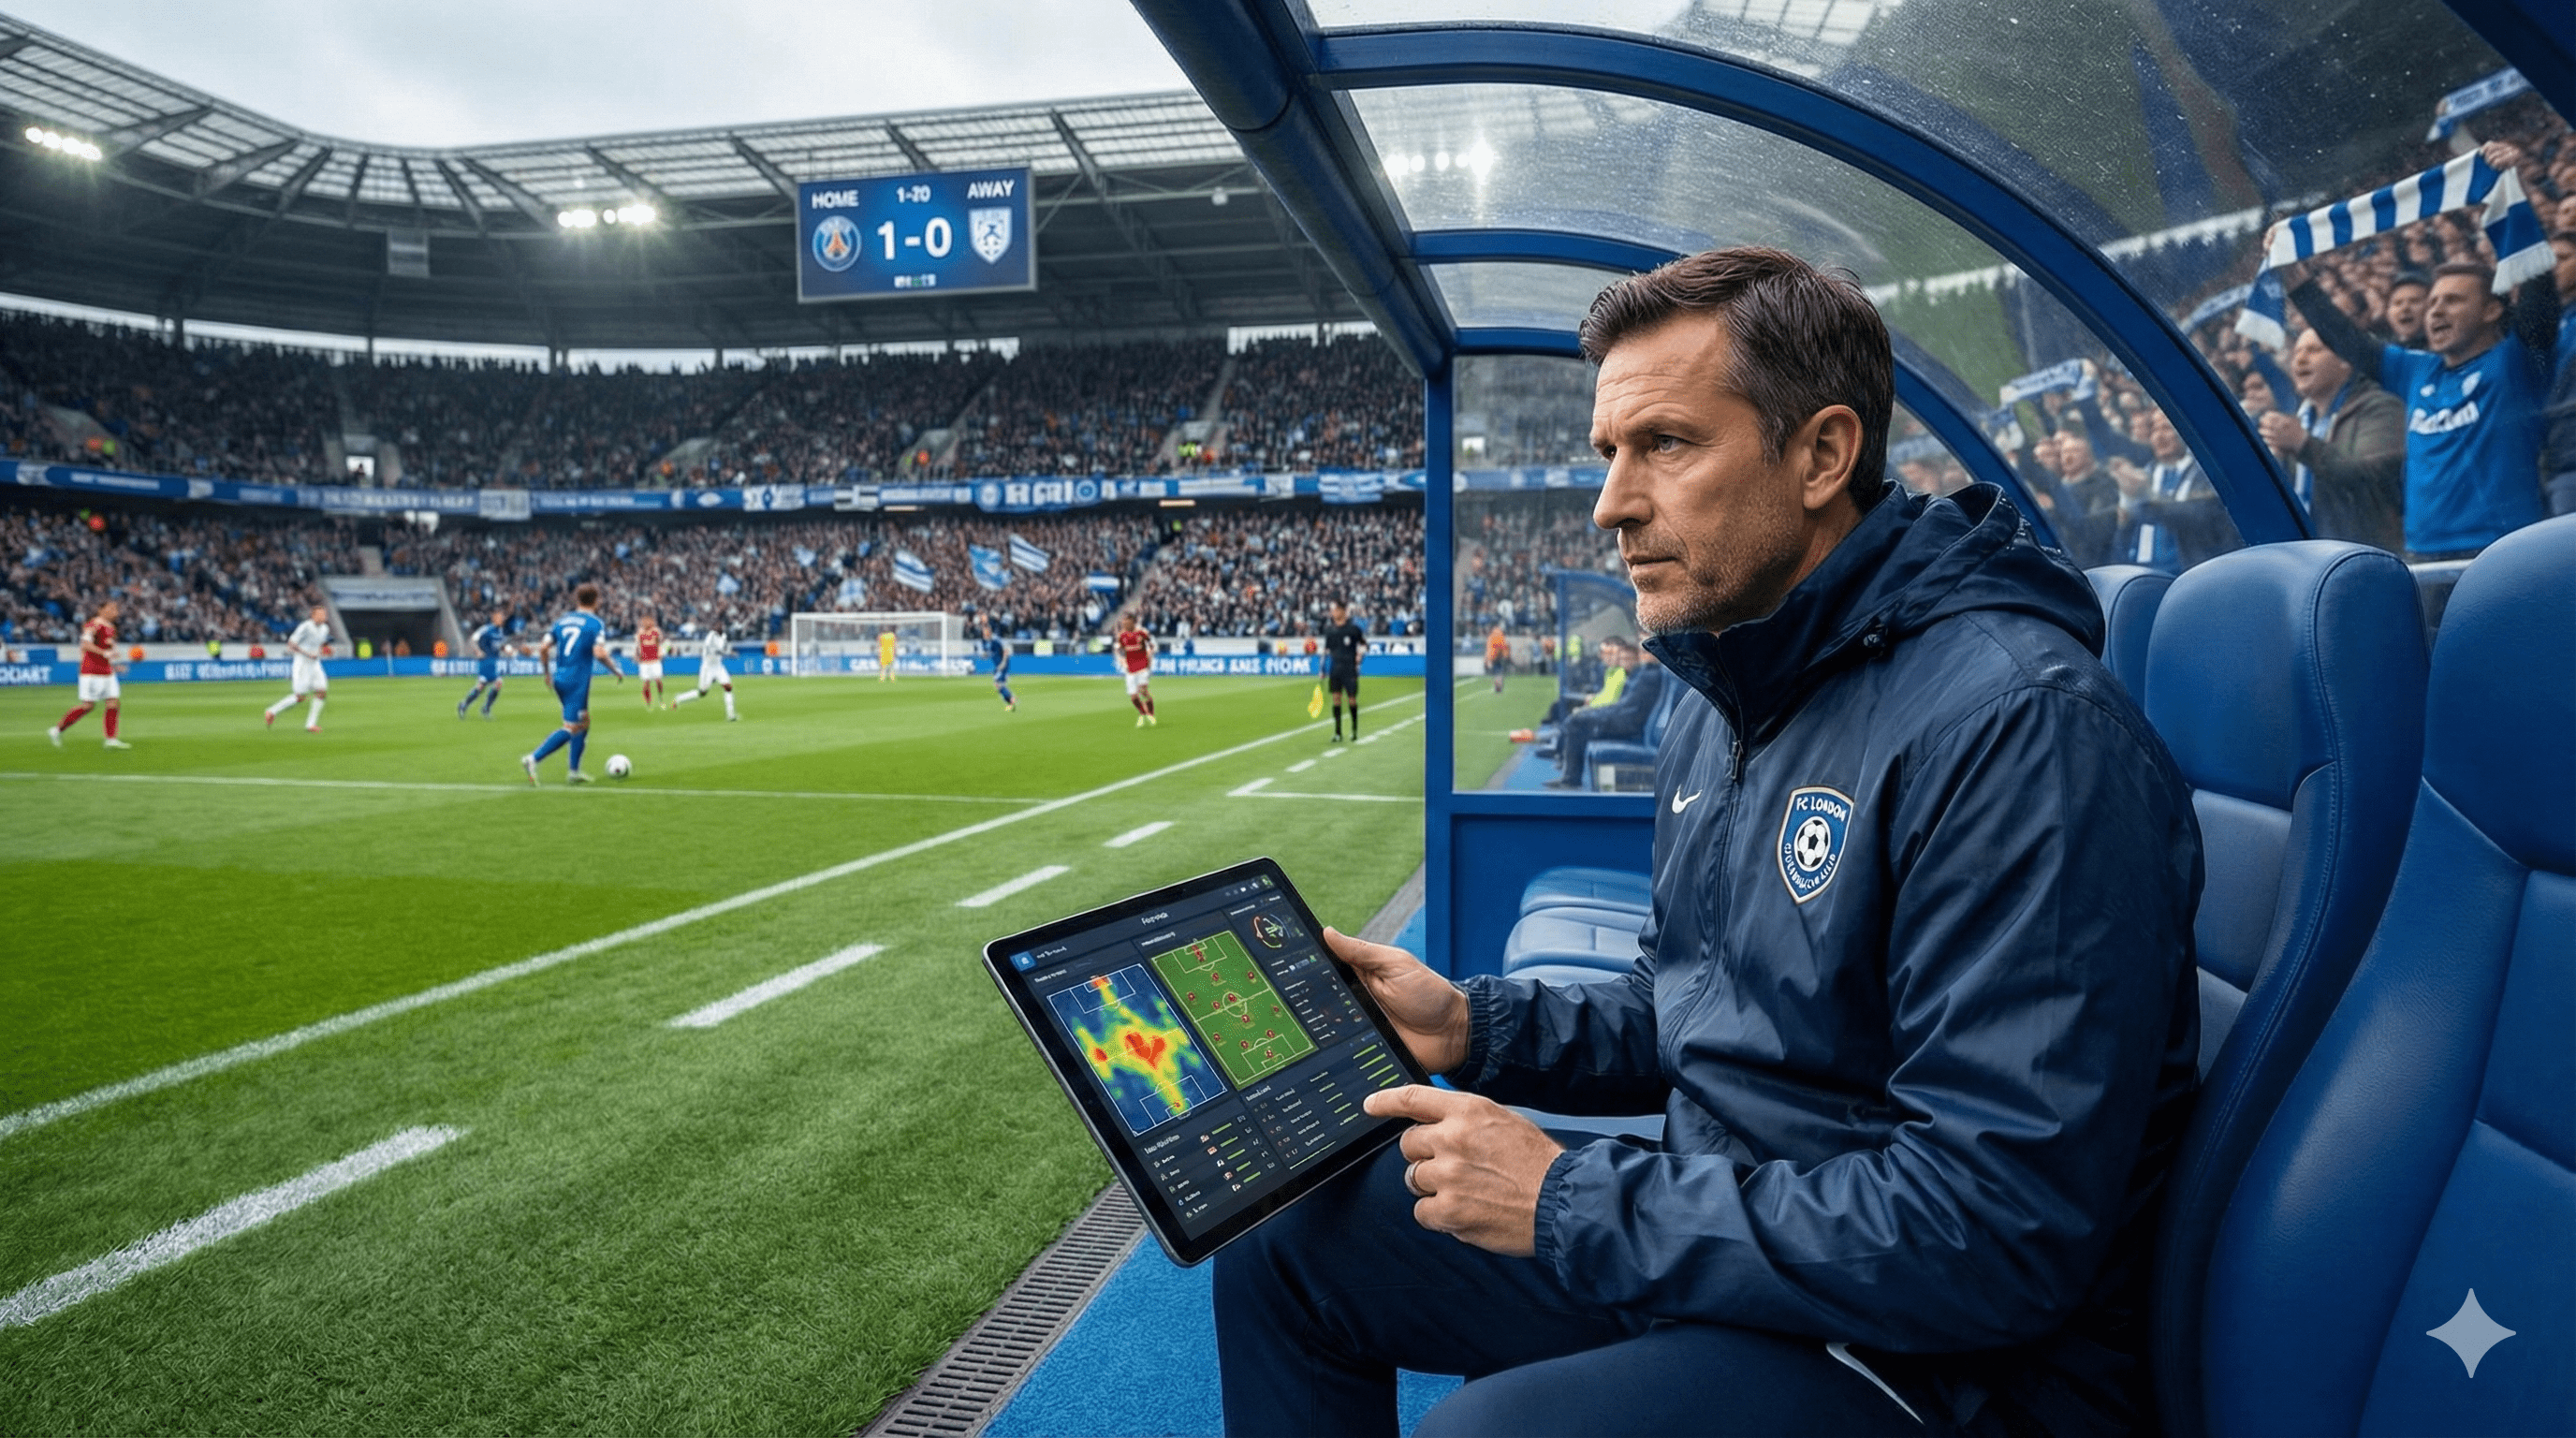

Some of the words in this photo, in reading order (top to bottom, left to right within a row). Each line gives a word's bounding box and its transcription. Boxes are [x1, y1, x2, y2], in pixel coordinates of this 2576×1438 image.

[812, 190, 859, 209] HOME
[967, 179, 1015, 199] AWAY
[877, 216, 953, 260] 1-0
[562, 625, 581, 656] 7
[1796, 796, 1808, 811] FC
[1810, 796, 1847, 822] LONDON
